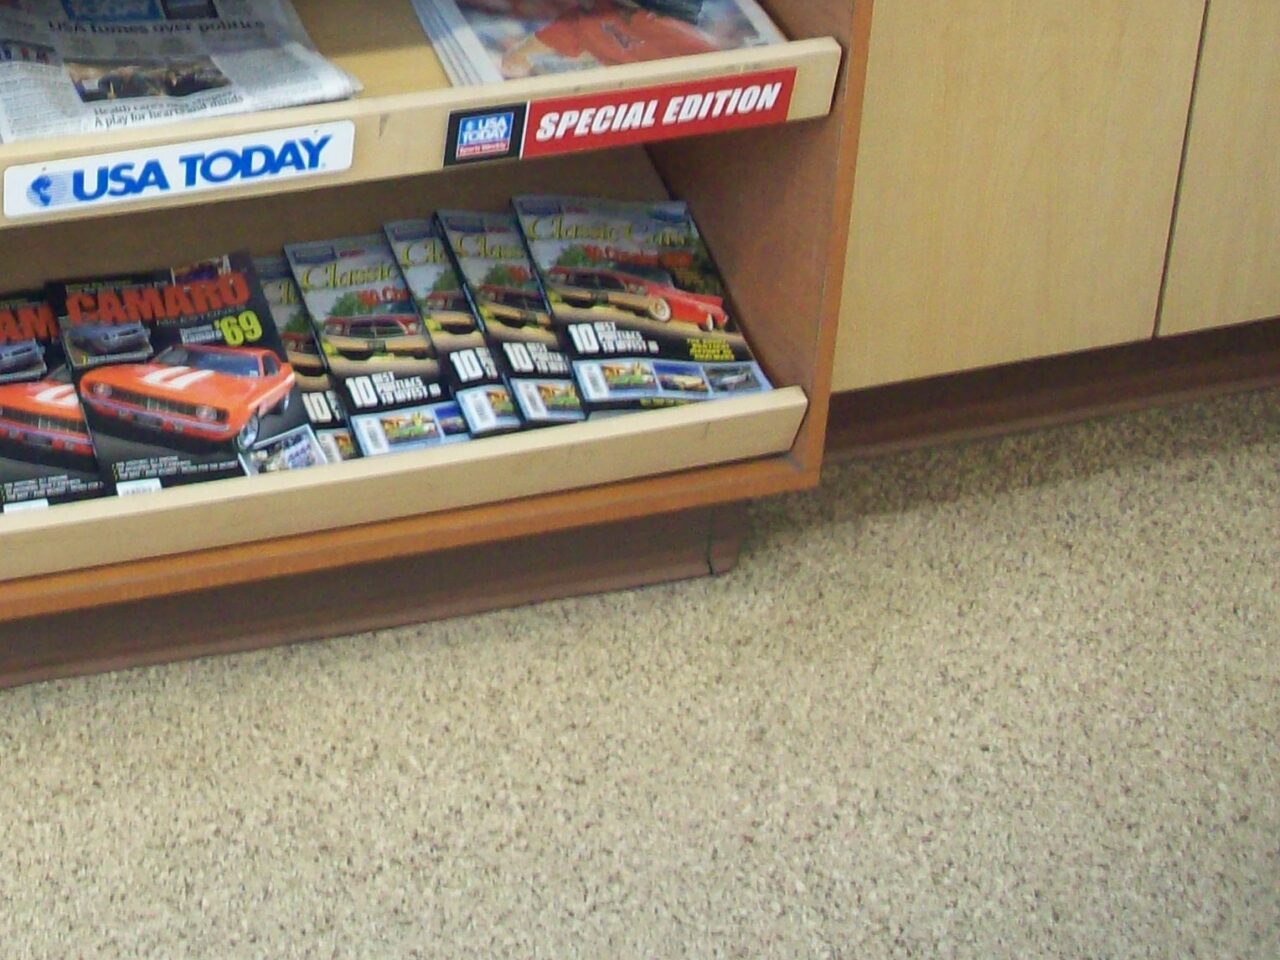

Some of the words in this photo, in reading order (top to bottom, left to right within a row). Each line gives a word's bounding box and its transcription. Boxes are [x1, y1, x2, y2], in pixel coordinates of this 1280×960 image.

[49, 20, 85, 33] USA
[152, 21, 192, 33] over
[199, 18, 265, 34] politics
[94, 115, 103, 128] A
[105, 114, 128, 128] play
[130, 111, 147, 124] for
[478, 115, 508, 130] USA
[536, 98, 658, 142] SPECIAL
[662, 81, 782, 127] EDITION
[462, 126, 506, 145] TODAY
[73, 158, 170, 203] USA
[179, 134, 332, 187] TODAY
[66, 270, 251, 327] CAMARO
[214, 309, 263, 346] '69
[568, 323, 600, 354] 10
[450, 348, 483, 383] 10
[502, 342, 535, 373] 10
[345, 375, 379, 408] 10
[302, 392, 333, 423] 10
